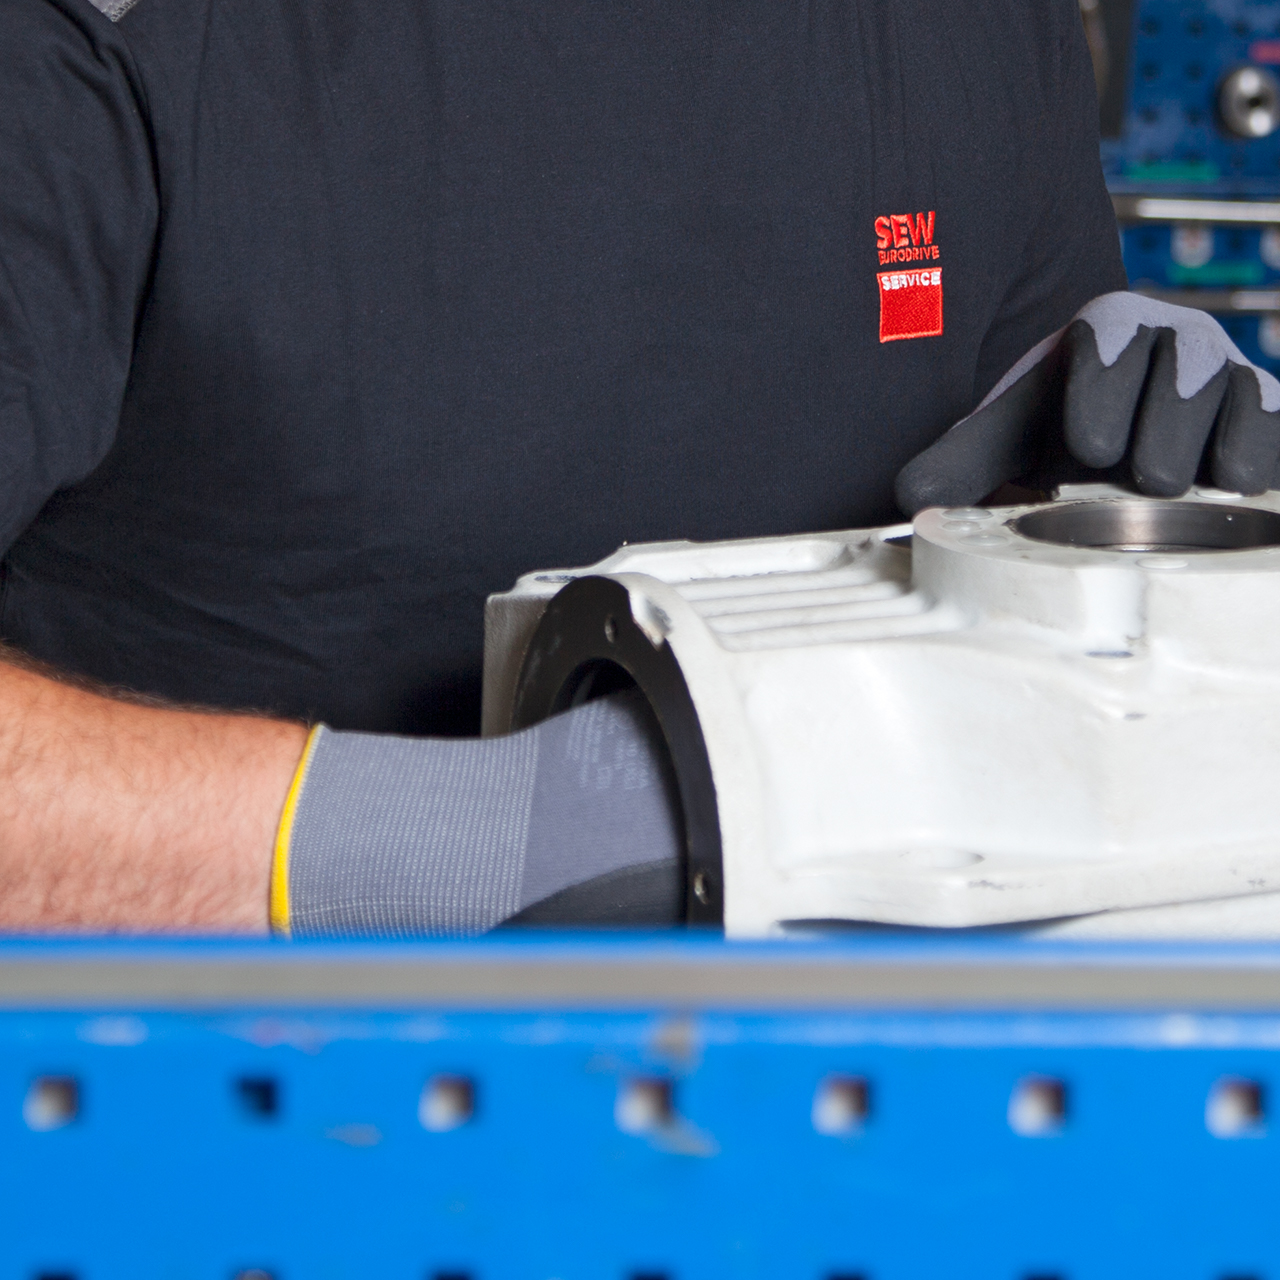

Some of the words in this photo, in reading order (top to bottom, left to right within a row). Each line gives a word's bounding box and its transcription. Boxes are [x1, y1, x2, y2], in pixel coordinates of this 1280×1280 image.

[874, 210, 936, 249] SEW
[878, 245, 940, 265] EURODRIVE
[881, 271, 941, 291] SERVICE
